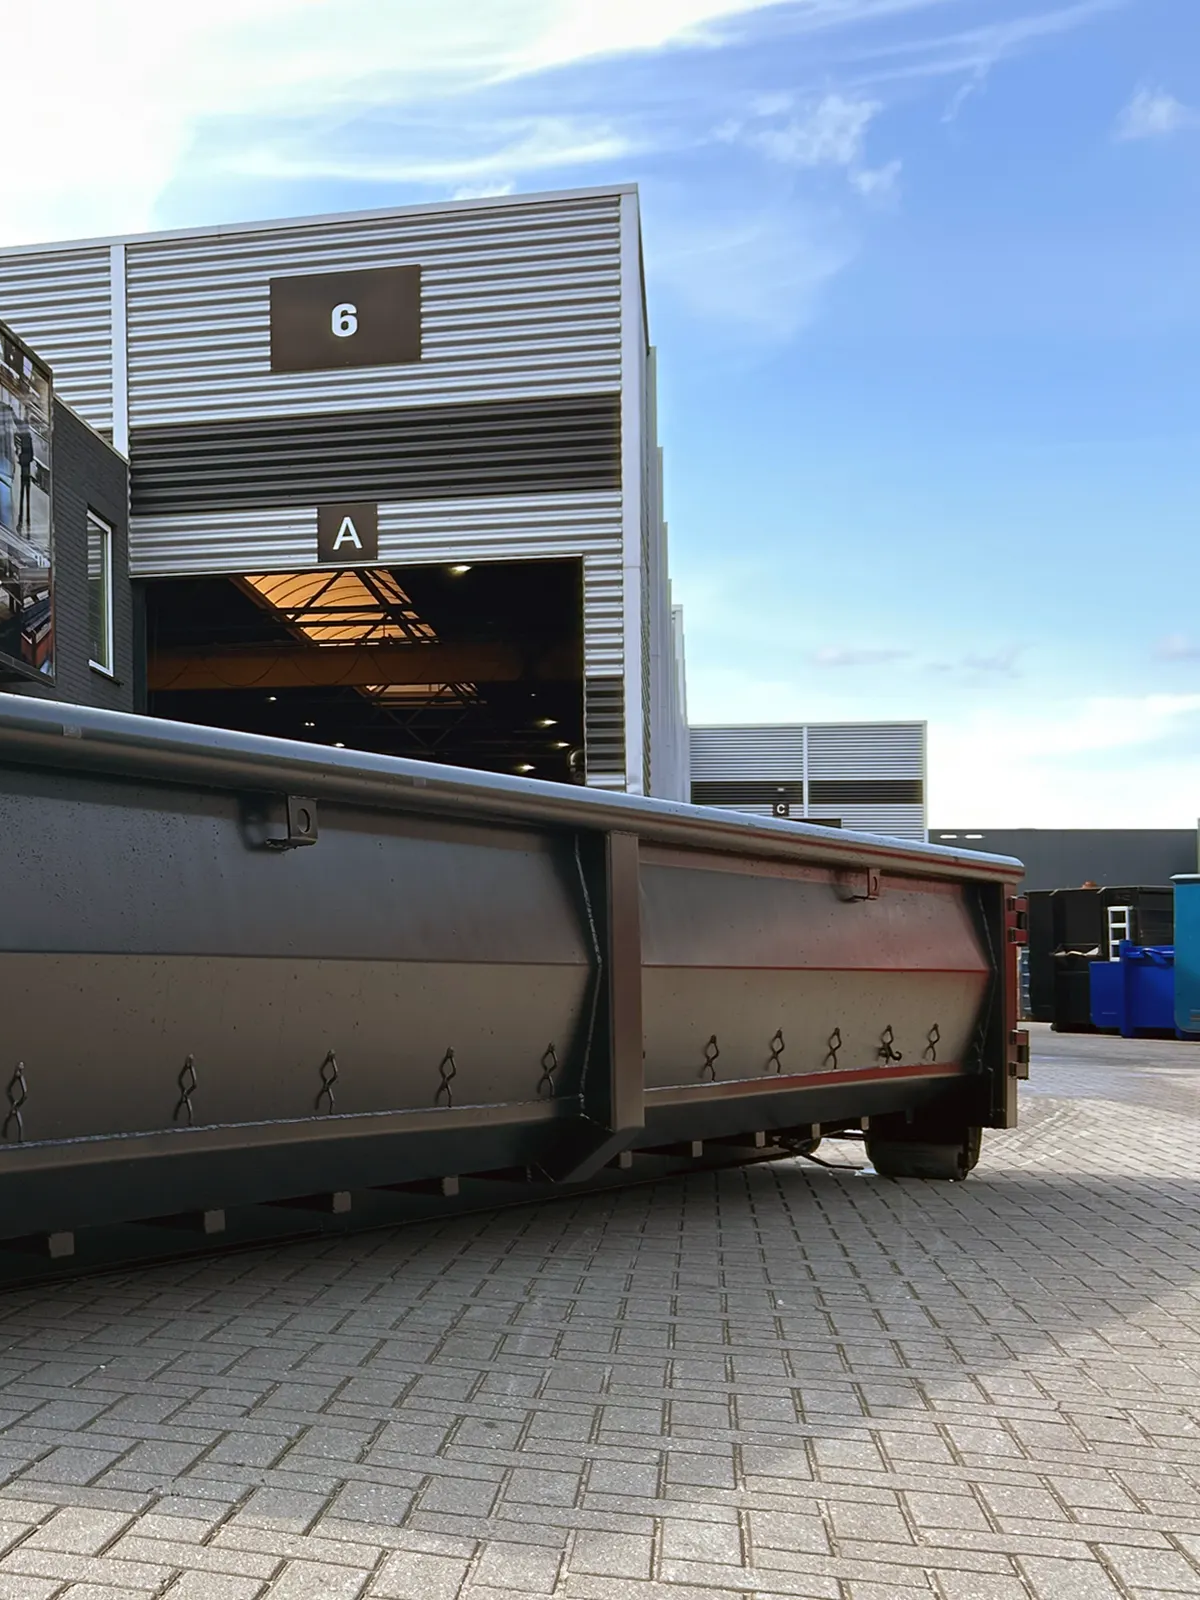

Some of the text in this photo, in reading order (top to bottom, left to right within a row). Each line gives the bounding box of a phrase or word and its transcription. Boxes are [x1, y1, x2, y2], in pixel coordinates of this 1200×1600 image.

[330, 302, 358, 337] 6
[332, 516, 363, 550] A
[776, 803, 786, 814] C
